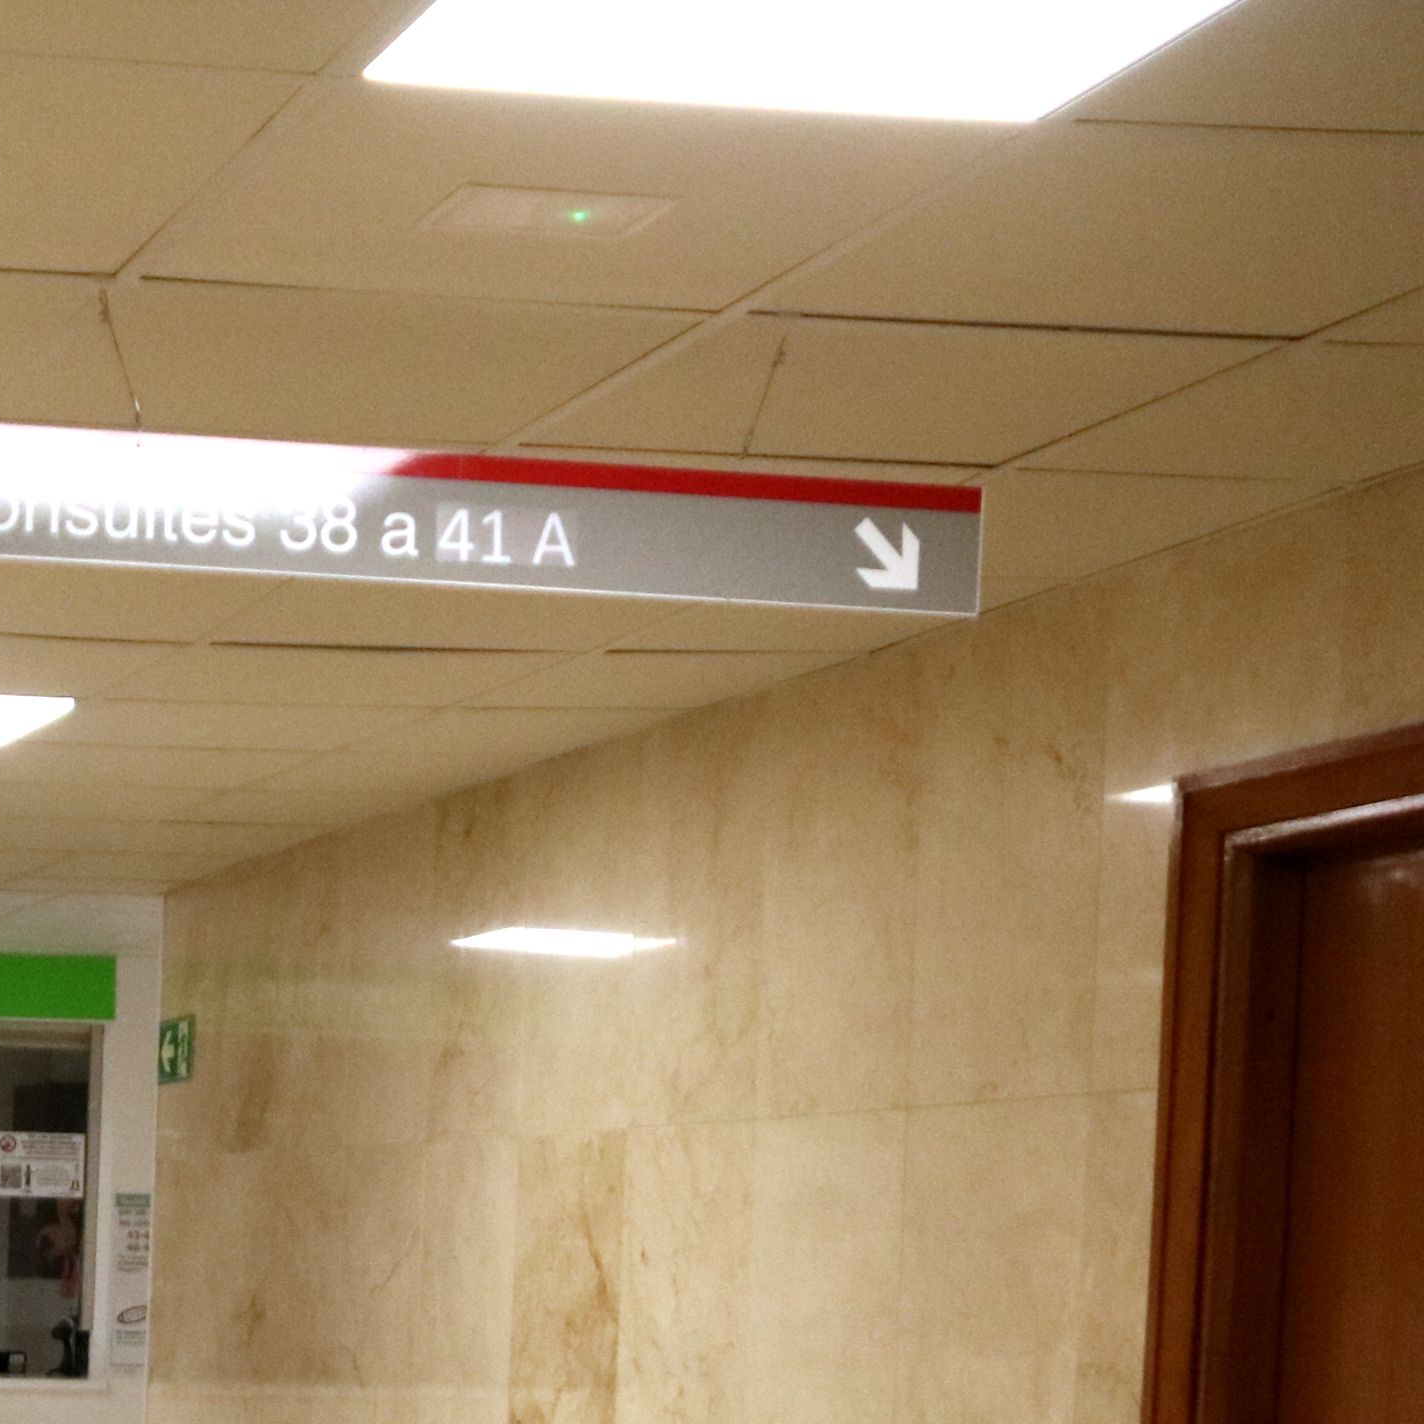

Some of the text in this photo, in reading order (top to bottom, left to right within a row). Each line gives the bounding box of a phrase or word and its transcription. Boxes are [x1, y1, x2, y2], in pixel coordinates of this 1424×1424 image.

[279, 496, 358, 553] 38
[380, 510, 419, 557] a
[438, 508, 512, 563] 41
[532, 511, 576, 566] A
